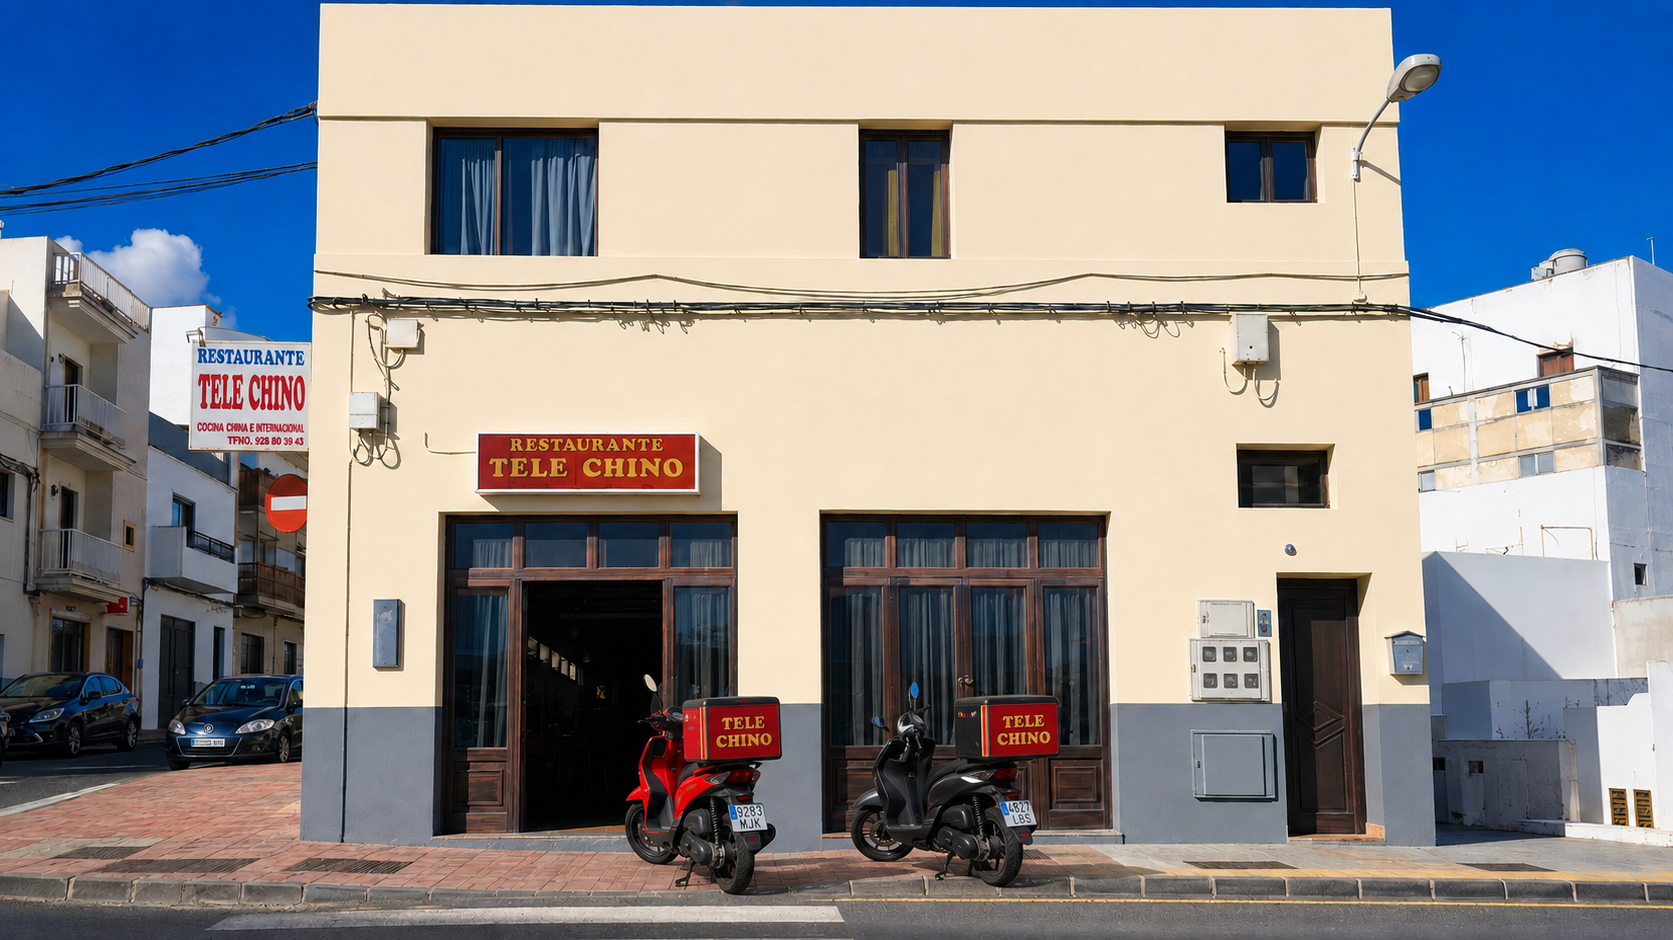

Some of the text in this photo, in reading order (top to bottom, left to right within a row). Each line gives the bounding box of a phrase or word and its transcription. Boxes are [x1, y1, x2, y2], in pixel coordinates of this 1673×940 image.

[197, 348, 305, 366] RESTAURANTE
[198, 373, 306, 412] TELE CHINO
[197, 422, 305, 433] COCINA CHINA E INTERNACIONAL
[227, 436, 253, 445] TFNO.
[255, 436, 270, 446] 928
[271, 437, 282, 446] 80
[510, 438, 664, 452] RESTAURANTE
[489, 457, 684, 478] TELE CHINO
[721, 716, 765, 730] TELE
[1002, 714, 1045, 729] TELE
[715, 732, 773, 748] CHINO
[996, 730, 1051, 746] CHINO
[736, 805, 763, 818] 9283
[1008, 801, 1030, 813] 4827
[740, 817, 762, 830] MJK
[1012, 813, 1032, 825] LBS
